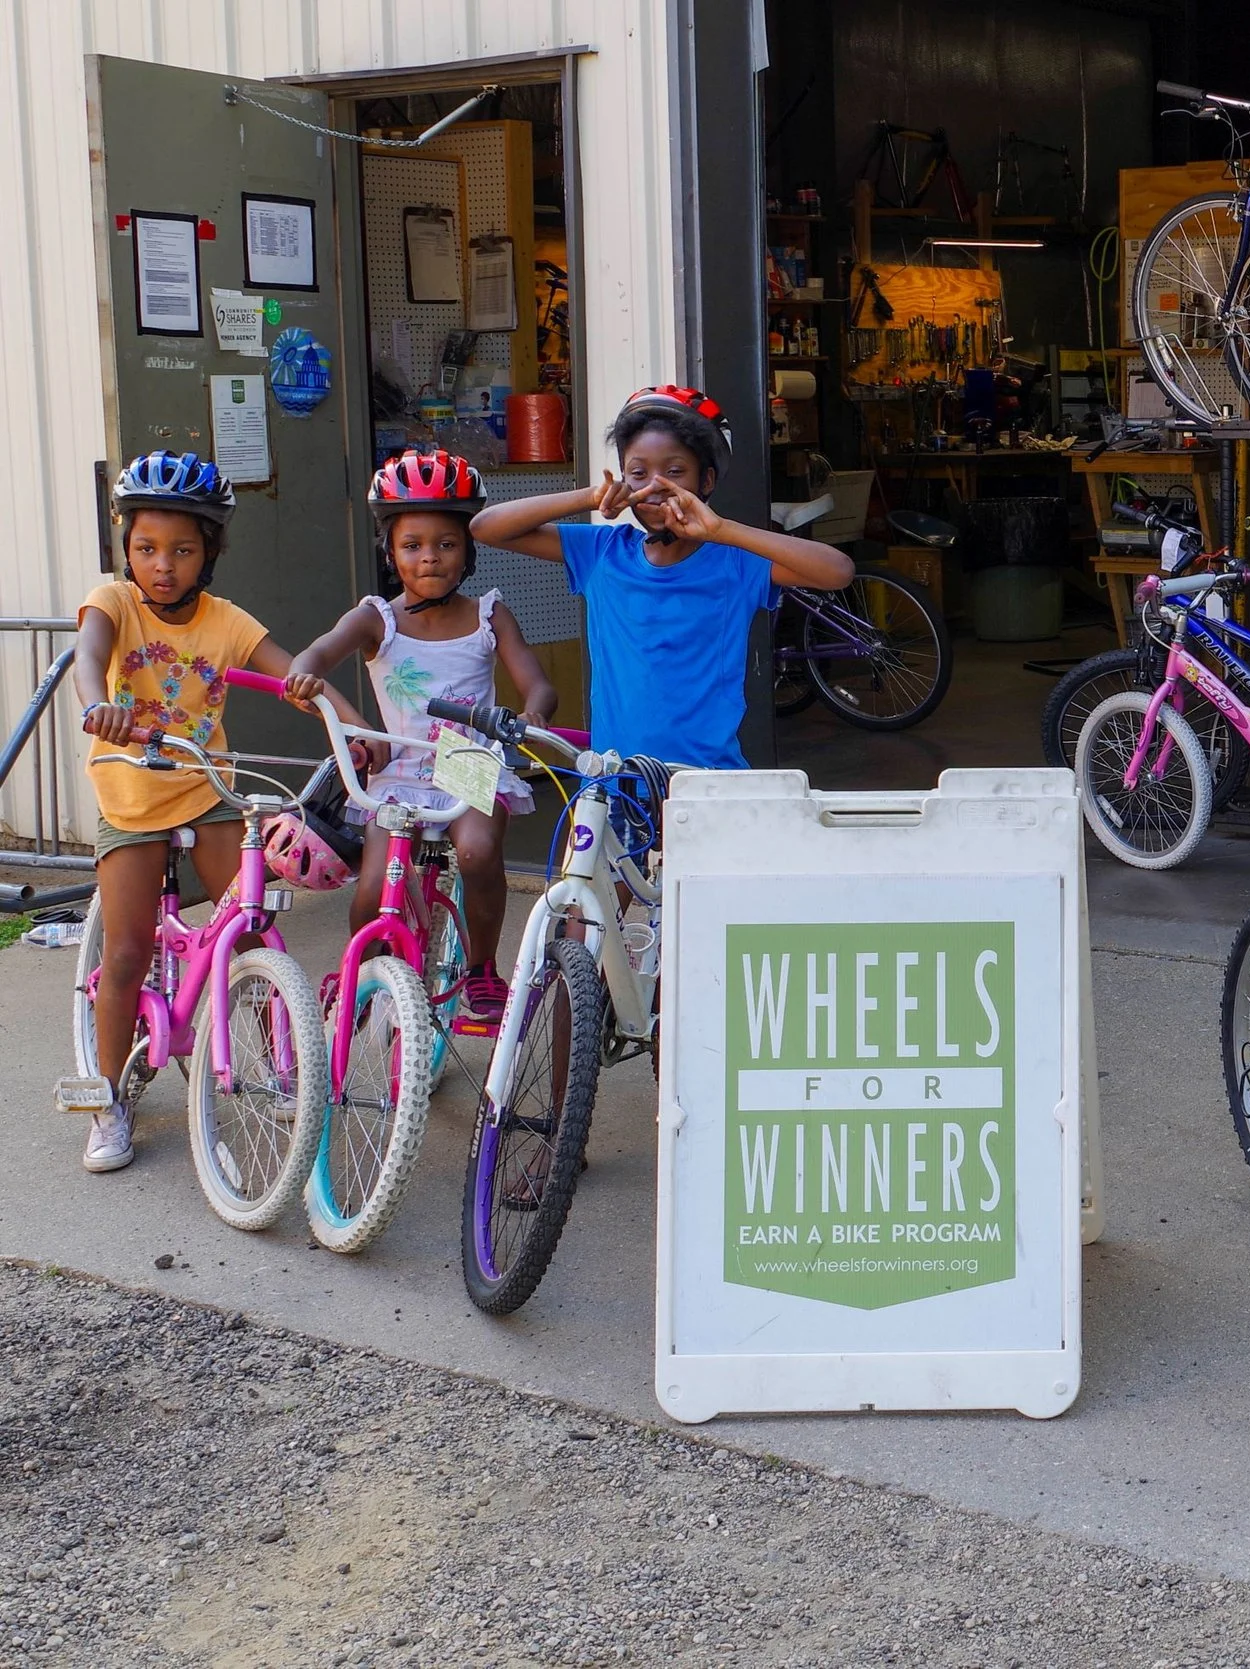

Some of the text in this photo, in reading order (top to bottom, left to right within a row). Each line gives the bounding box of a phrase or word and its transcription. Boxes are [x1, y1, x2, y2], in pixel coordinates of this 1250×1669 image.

[226, 314, 256, 324] SHARES
[1197, 675, 1234, 712] taffy
[742, 950, 1001, 1058] WHEELS
[805, 1075, 943, 1101] FOR
[470, 1100, 485, 1159] GIANT
[739, 1120, 1001, 1214] WINNERS
[739, 1221, 1002, 1245] EARN A BIKE PROGRAM
[753, 1256, 978, 1276] www.wheelsforwinners.org
